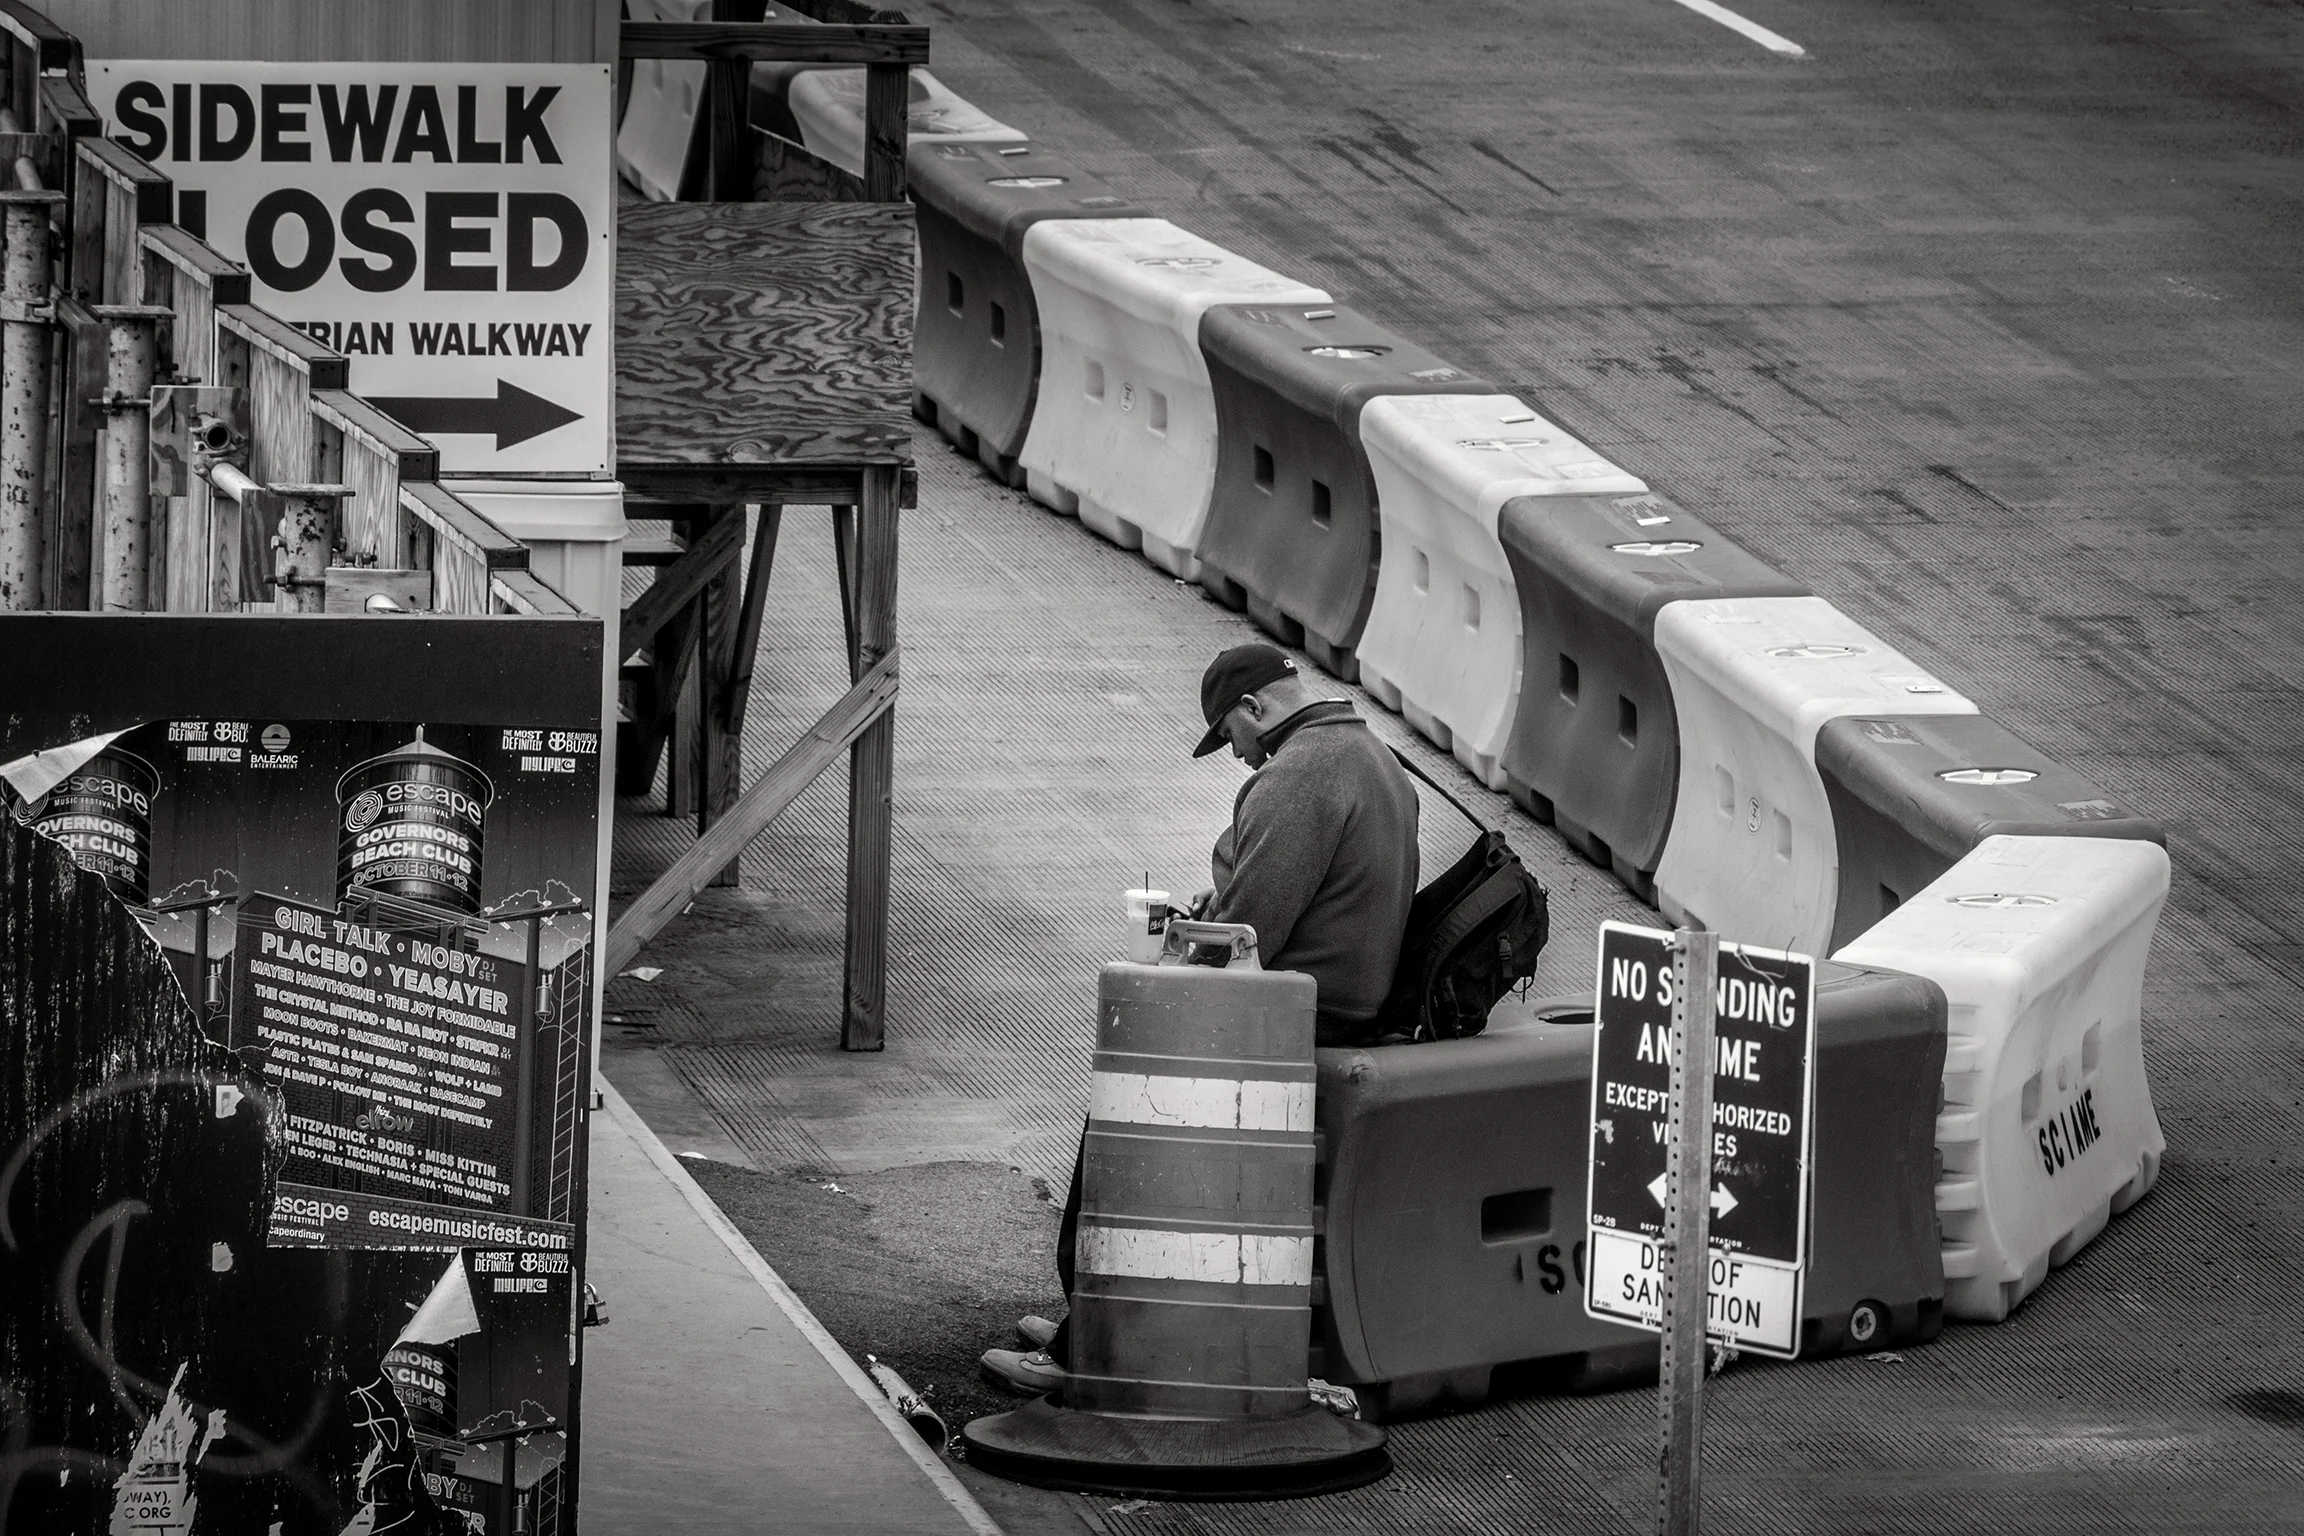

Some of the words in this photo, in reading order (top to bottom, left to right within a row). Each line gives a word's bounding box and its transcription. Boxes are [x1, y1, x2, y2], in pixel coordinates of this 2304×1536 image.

[114, 81, 563, 164] SIDEWALK
[409, 322, 592, 357] WALKWAY
[168, 728, 209, 742] DEFINITELY
[180, 721, 209, 731] MOST
[231, 730, 249, 743] BU
[514, 730, 543, 741] MOST
[566, 732, 597, 741] BEAUTIFUL
[502, 735, 543, 751] DEFINITELY
[565, 740, 598, 754] BUZZZ
[250, 754, 299, 764] BALEARIC
[54, 797, 78, 807] MUSIC
[81, 797, 116, 810] FESTIVAL
[386, 783, 482, 825] escape
[387, 804, 412, 815] MUSIC
[415, 804, 450, 819] FESTIVAL
[89, 835, 138, 865] CLUB
[356, 823, 470, 852] GOVERNORS
[351, 841, 416, 869] BEACH
[421, 844, 472, 874] CLUB
[353, 861, 428, 886] OCTOBER
[275, 906, 326, 939] GIRL
[333, 919, 392, 956] TALK
[411, 940, 481, 977] MOBY
[261, 931, 368, 978] PLACEBO
[388, 963, 509, 1015] YEASAYER
[478, 971, 498, 983] SET
[482, 961, 495, 972] DJ
[250, 959, 295, 983] MAYER
[295, 970, 376, 1004] HAWTHORNE
[384, 993, 410, 1012] THE
[410, 1000, 436, 1019] JOY
[436, 1006, 516, 1039] FORMIDABLE
[1611, 957, 1647, 1002] NO
[1656, 965, 1796, 1028] SNDING
[254, 983, 278, 1000] THE
[278, 989, 329, 1014] CRYSTAL
[329, 1002, 379, 1026] METHOD
[386, 1016, 403, 1033] RA
[404, 1021, 421, 1037] RA
[421, 1025, 449, 1044] RIOT
[456, 1034, 500, 1057] STRFKR
[263, 1006, 299, 1026] MOON
[300, 1016, 339, 1036] BOOTS
[347, 1027, 409, 1053] BAKERMAT
[417, 1045, 449, 1064] NEON
[450, 1053, 491, 1075] INDIAN
[1636, 1022, 1762, 1082] ANIME
[257, 1025, 300, 1046] PLASTIC
[301, 1036, 340, 1056] PLATES
[341, 1047, 350, 1059] &
[351, 1049, 374, 1065] SAM
[375, 1055, 418, 1076] SPARRO
[434, 1070, 464, 1087] WOLF
[473, 1079, 502, 1097] LAMB
[271, 1046, 300, 1063] ASTR
[307, 1055, 339, 1074] TESLA
[341, 1063, 364, 1079] BOY
[370, 1072, 423, 1095] ANORAAK
[429, 1086, 487, 1110] BASECAMP
[283, 1067, 291, 1079] &
[291, 1069, 318, 1086] DAVE
[318, 1076, 327, 1087] P
[332, 1080, 372, 1098] FOLLOW
[372, 1089, 388, 1103] ME
[393, 1094, 413, 1109] THE
[413, 1100, 440, 1116] MOST
[440, 1107, 493, 1129] DEFINITELY
[1605, 1080, 1669, 1114] EXCEPT
[355, 1108, 415, 1132] elrow
[2039, 1088, 2101, 1177] SCIAME
[290, 1114, 368, 1145] FITZPATRICK
[377, 1136, 415, 1157] BORIS
[425, 1148, 455, 1167] MISS
[456, 1156, 497, 1178] KITTIN
[297, 1146, 316, 1160] BOO
[321, 1153, 344, 1167] ALEX
[344, 1158, 380, 1176] ENGLISH
[386, 1169, 411, 1184] MARC
[411, 1175, 437, 1190] MAYA
[442, 1183, 463, 1197] TONI
[464, 1188, 493, 1205] VARGA
[301, 1132, 337, 1153] LEGER
[345, 1143, 408, 1171] TECHNASIA
[418, 1162, 465, 1185] SPECIAL
[466, 1175, 511, 1196] GUESTS
[289, 1214, 319, 1226] FESTIVAL
[368, 1209, 567, 1250] escapemusicfest.com
[1640, 1222, 1660, 1233] DEPT
[474, 1257, 515, 1273] DEFINITELY
[486, 1251, 515, 1262] MOST
[537, 1260, 569, 1274] BUZZZ
[538, 1252, 569, 1262] BEAUTIFUL
[1711, 1258, 1743, 1288] OF
[1622, 1273, 1761, 1329] SANTION
[397, 1368, 447, 1397] CLUB
[455, 1492, 475, 1504] SET
[459, 1481, 473, 1494] DJ
